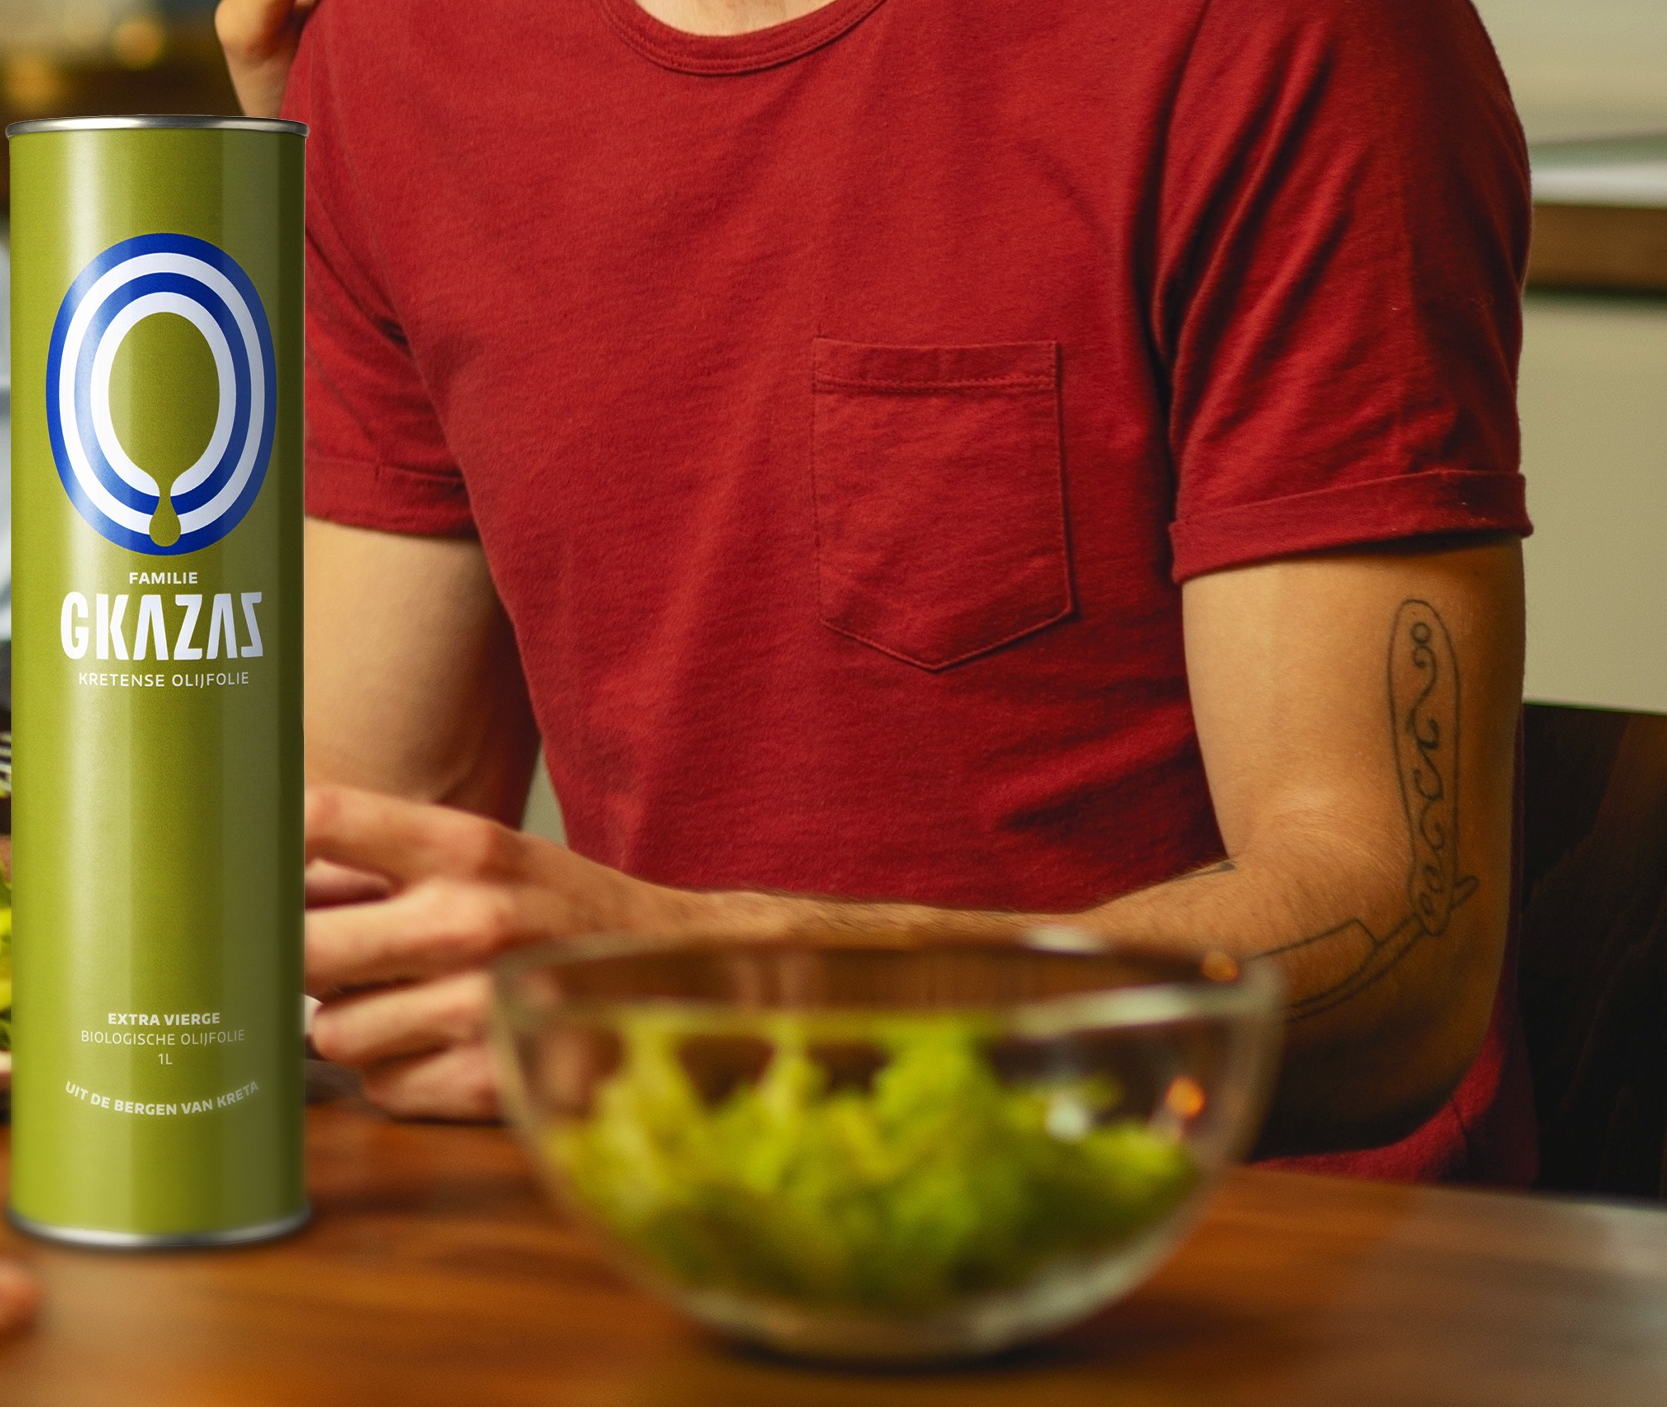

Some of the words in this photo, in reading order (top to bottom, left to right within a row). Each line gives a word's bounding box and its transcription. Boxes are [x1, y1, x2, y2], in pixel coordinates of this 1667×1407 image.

[129, 572, 198, 584] FAMILIE
[78, 672, 165, 687] KRETENSE
[172, 671, 249, 689] OLIJFOLIE
[108, 1012, 160, 1026] EXTRA
[163, 1012, 221, 1026] VIERGE
[81, 1030, 175, 1045] BIOLOGISCHE
[181, 1029, 245, 1047] OLIJFOLIE
[158, 1053, 173, 1065] 1L
[65, 1081, 89, 1101] UIT
[90, 1093, 110, 1109] DE
[114, 1099, 178, 1116] BERGEN
[181, 1098, 213, 1115] VAN
[217, 1081, 259, 1110] KRETA
